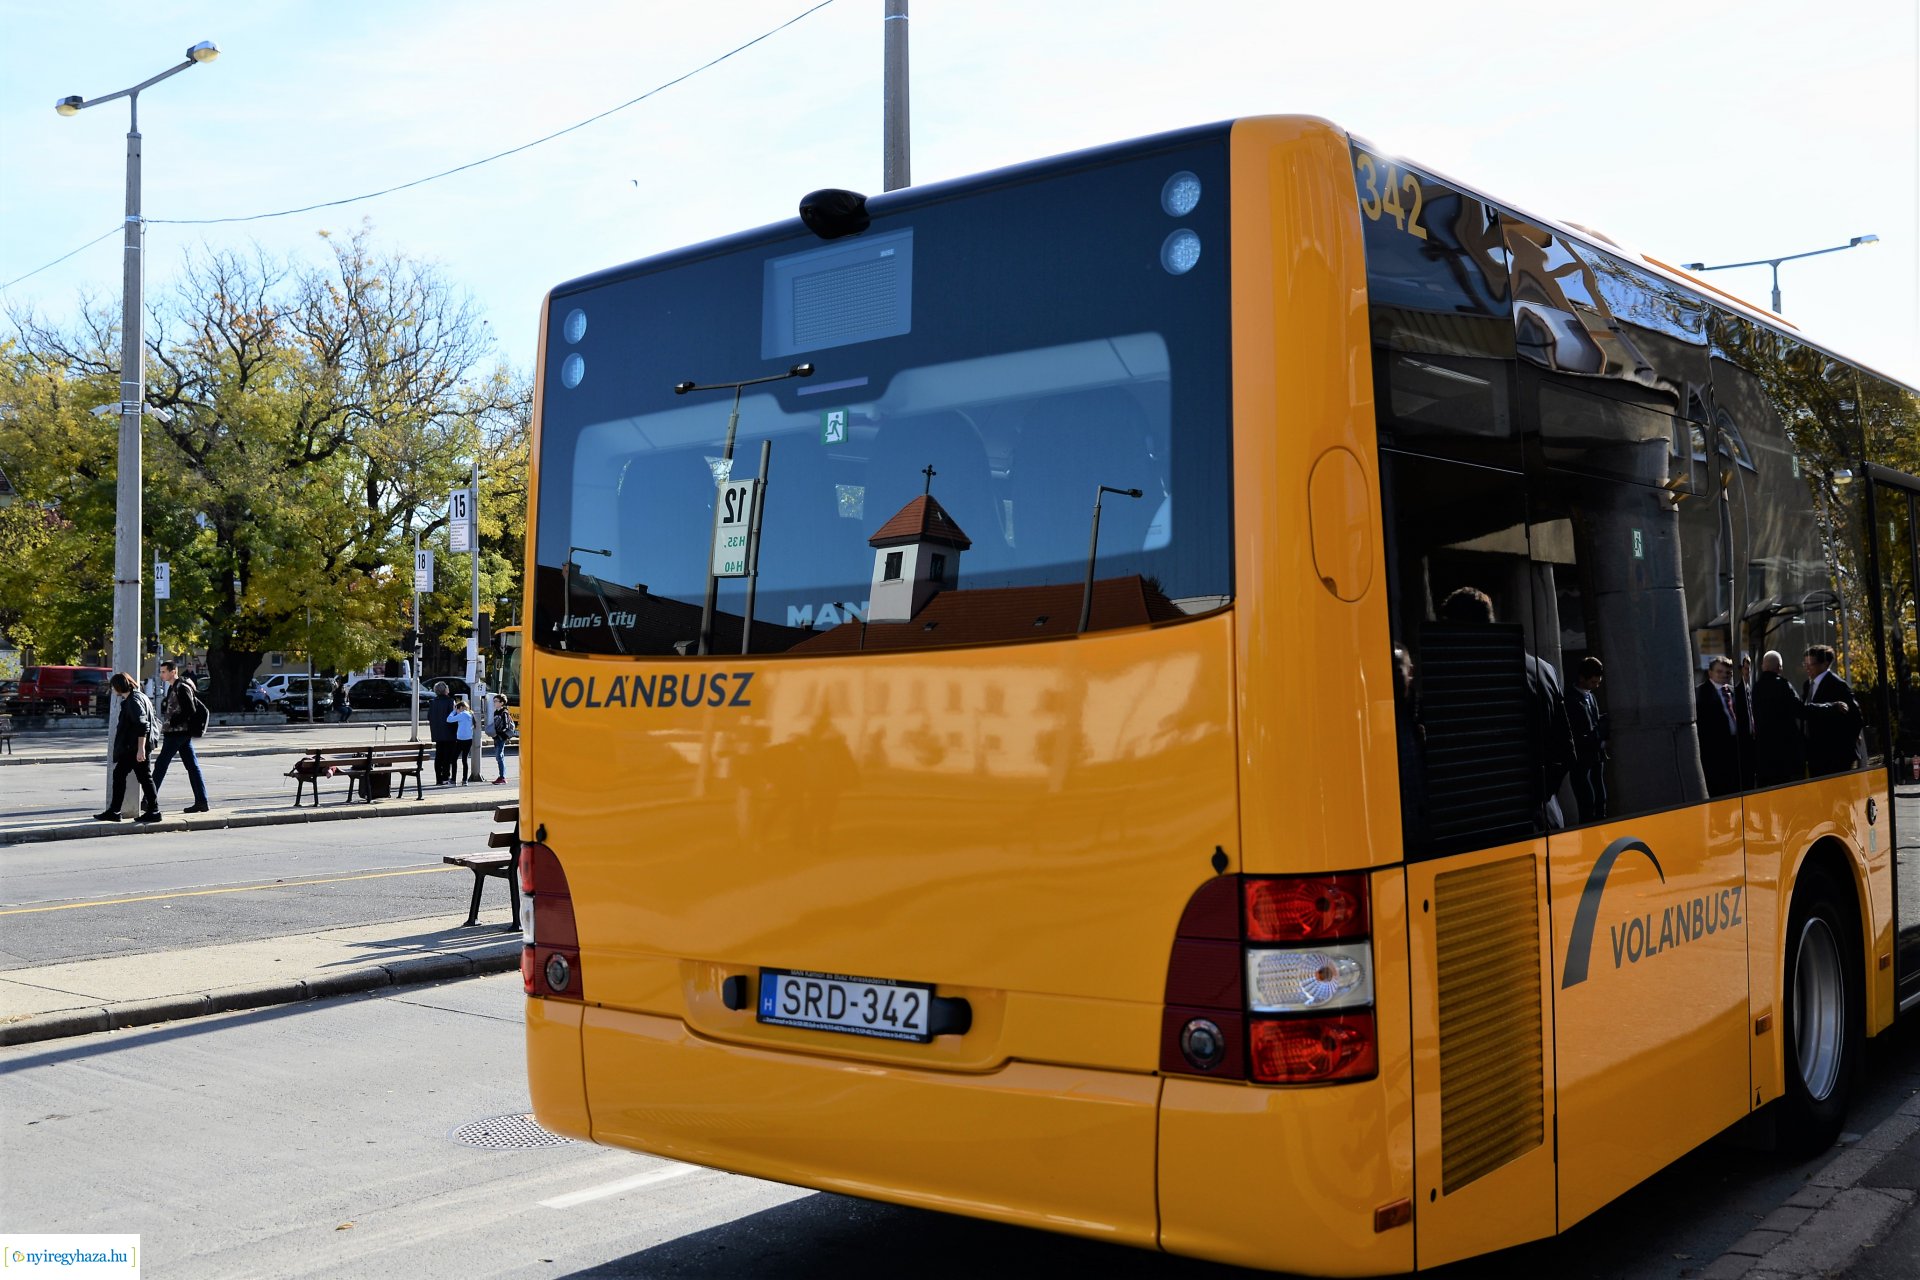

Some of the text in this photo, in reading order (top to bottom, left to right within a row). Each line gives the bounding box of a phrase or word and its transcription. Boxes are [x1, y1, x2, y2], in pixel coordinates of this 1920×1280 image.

[1357, 153, 1427, 241] 342
[454, 494, 466, 518] 15
[156, 566, 163, 579] 22
[417, 553, 426, 570] 18
[562, 611, 637, 630] Lion's City
[787, 600, 870, 628] MAN
[541, 671, 755, 709] VOLÁNBUSZ
[1610, 885, 1743, 969] VOLÁNBUSZ
[764, 998, 773, 1011] H
[783, 979, 919, 1029] SRD-342
